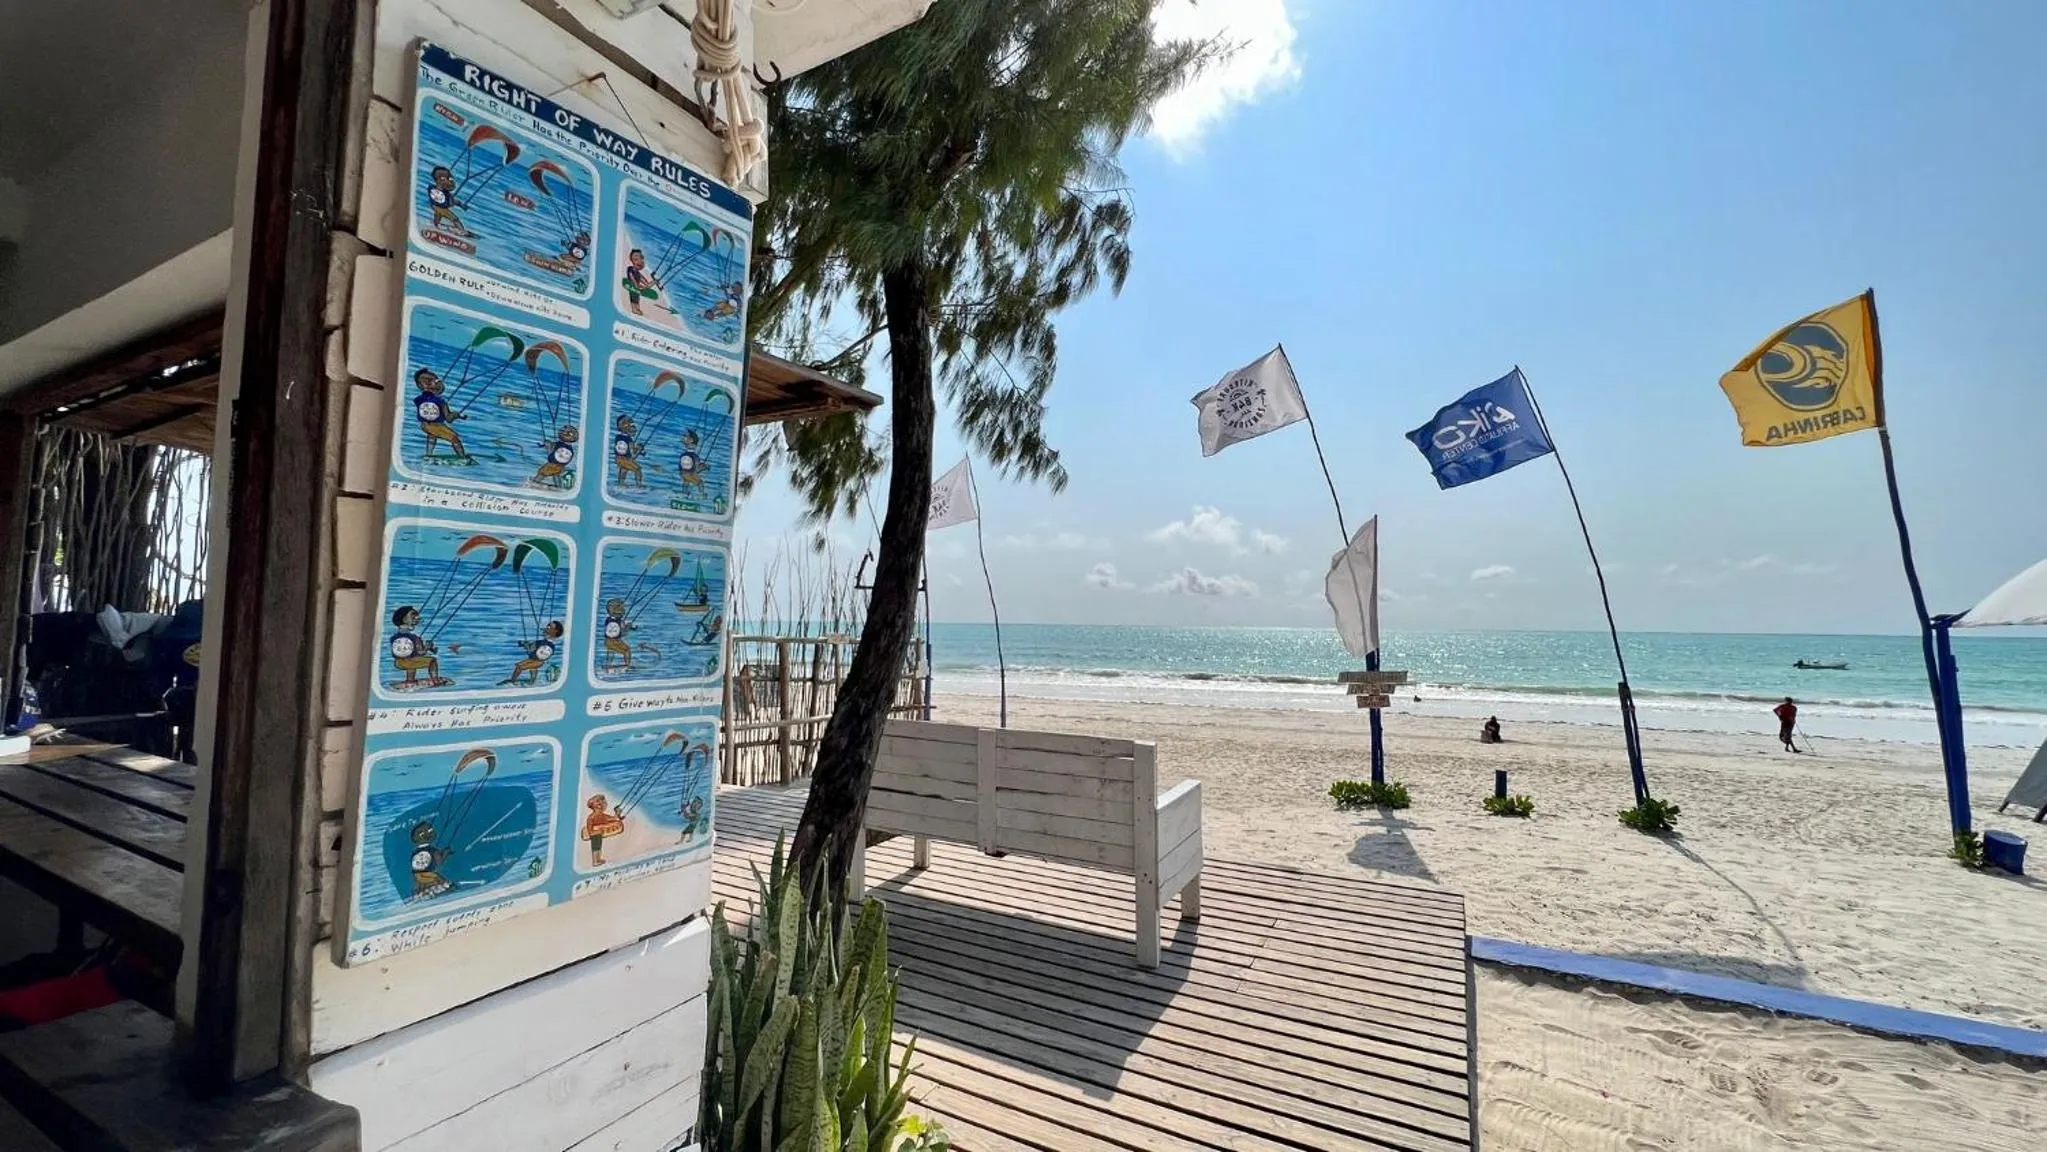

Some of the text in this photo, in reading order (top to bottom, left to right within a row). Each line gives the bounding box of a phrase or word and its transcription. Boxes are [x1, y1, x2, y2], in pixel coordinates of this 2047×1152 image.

[420, 65, 442, 86] The
[489, 100, 526, 122] Rider
[532, 117, 552, 136] Has
[557, 129, 573, 146] the
[464, 64, 711, 198] RIGHT OF WAY RULES
[409, 261, 456, 285] GOLDEN
[619, 698, 643, 709] Give
